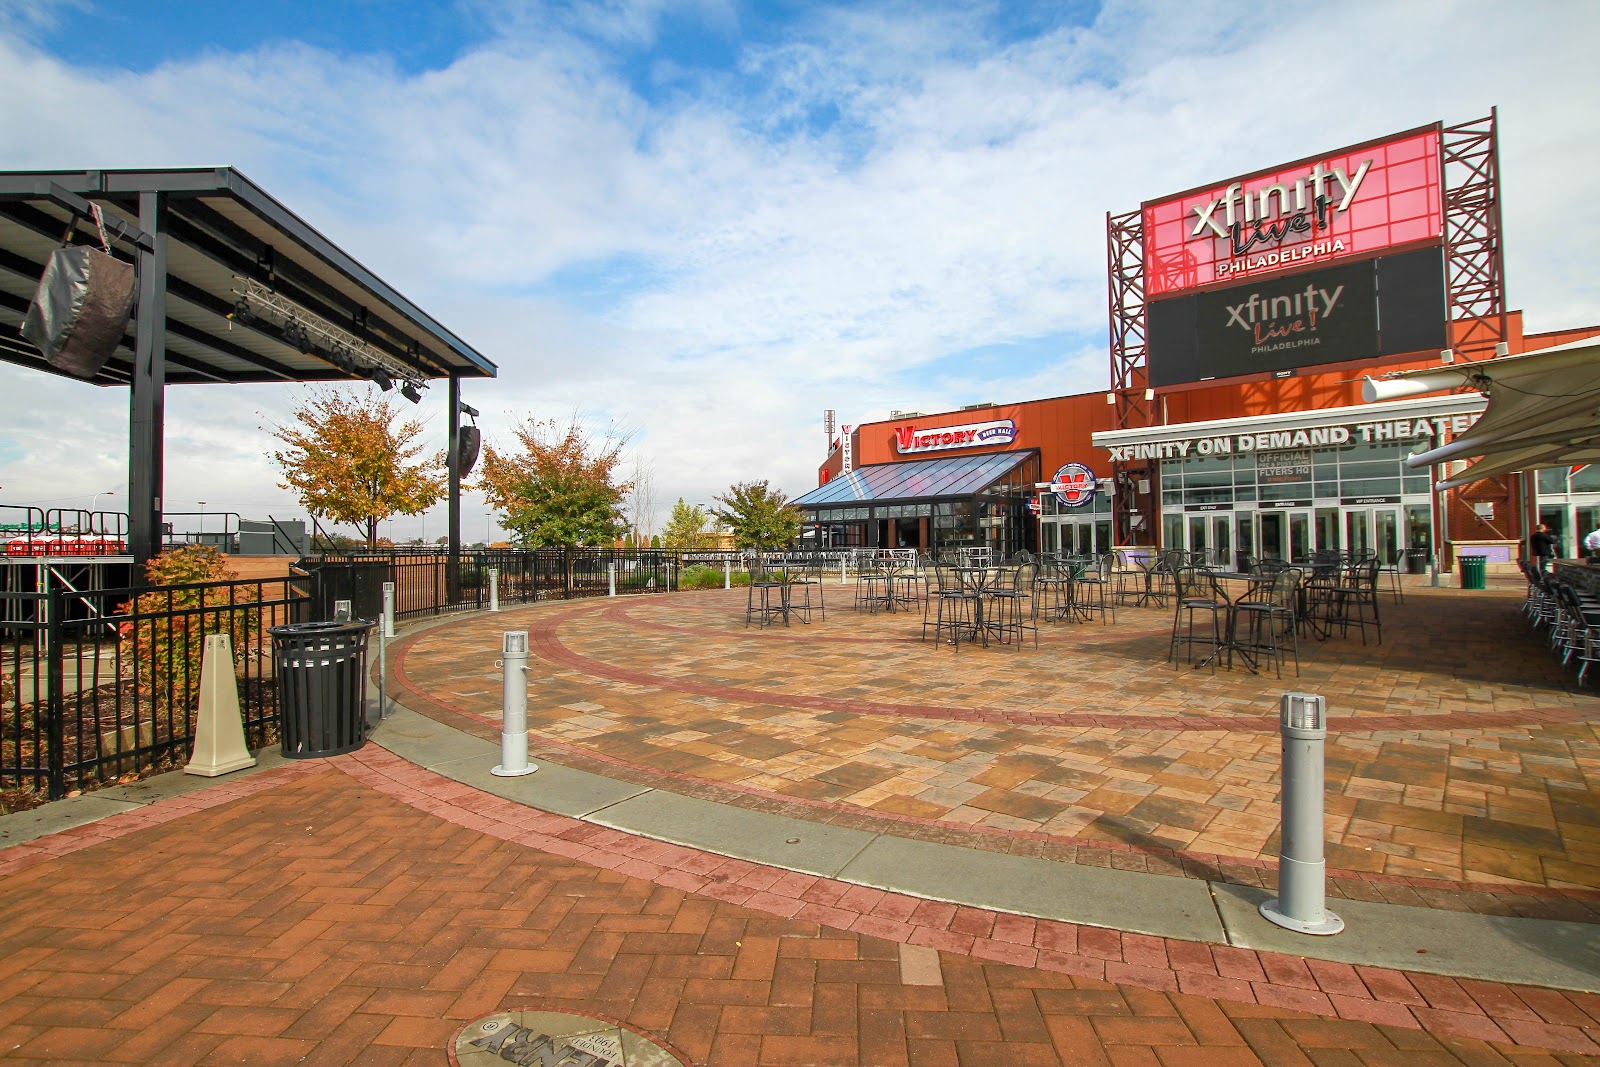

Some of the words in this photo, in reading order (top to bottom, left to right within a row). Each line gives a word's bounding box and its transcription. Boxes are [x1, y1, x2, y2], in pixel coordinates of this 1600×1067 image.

[1191, 159, 1373, 239] xfinity
[1231, 195, 1326, 255] Live!
[1218, 239, 1345, 275] PHILADELPHIA
[1225, 283, 1344, 330] xfinity
[1254, 308, 1317, 345] Live!
[1251, 337, 1321, 354] PHILADELPHIA
[894, 425, 978, 449] VICTORY
[1107, 441, 1192, 462] XFINITY
[1196, 437, 1232, 455] ON
[1238, 425, 1349, 452] DEMAND
[1259, 450, 1309, 463] OFFICIAL
[1259, 466, 1294, 477] FLYERS
[1296, 466, 1310, 475] HQ
[469, 1022, 624, 1067] ENRY
[571, 1038, 618, 1059] FOUNDED
